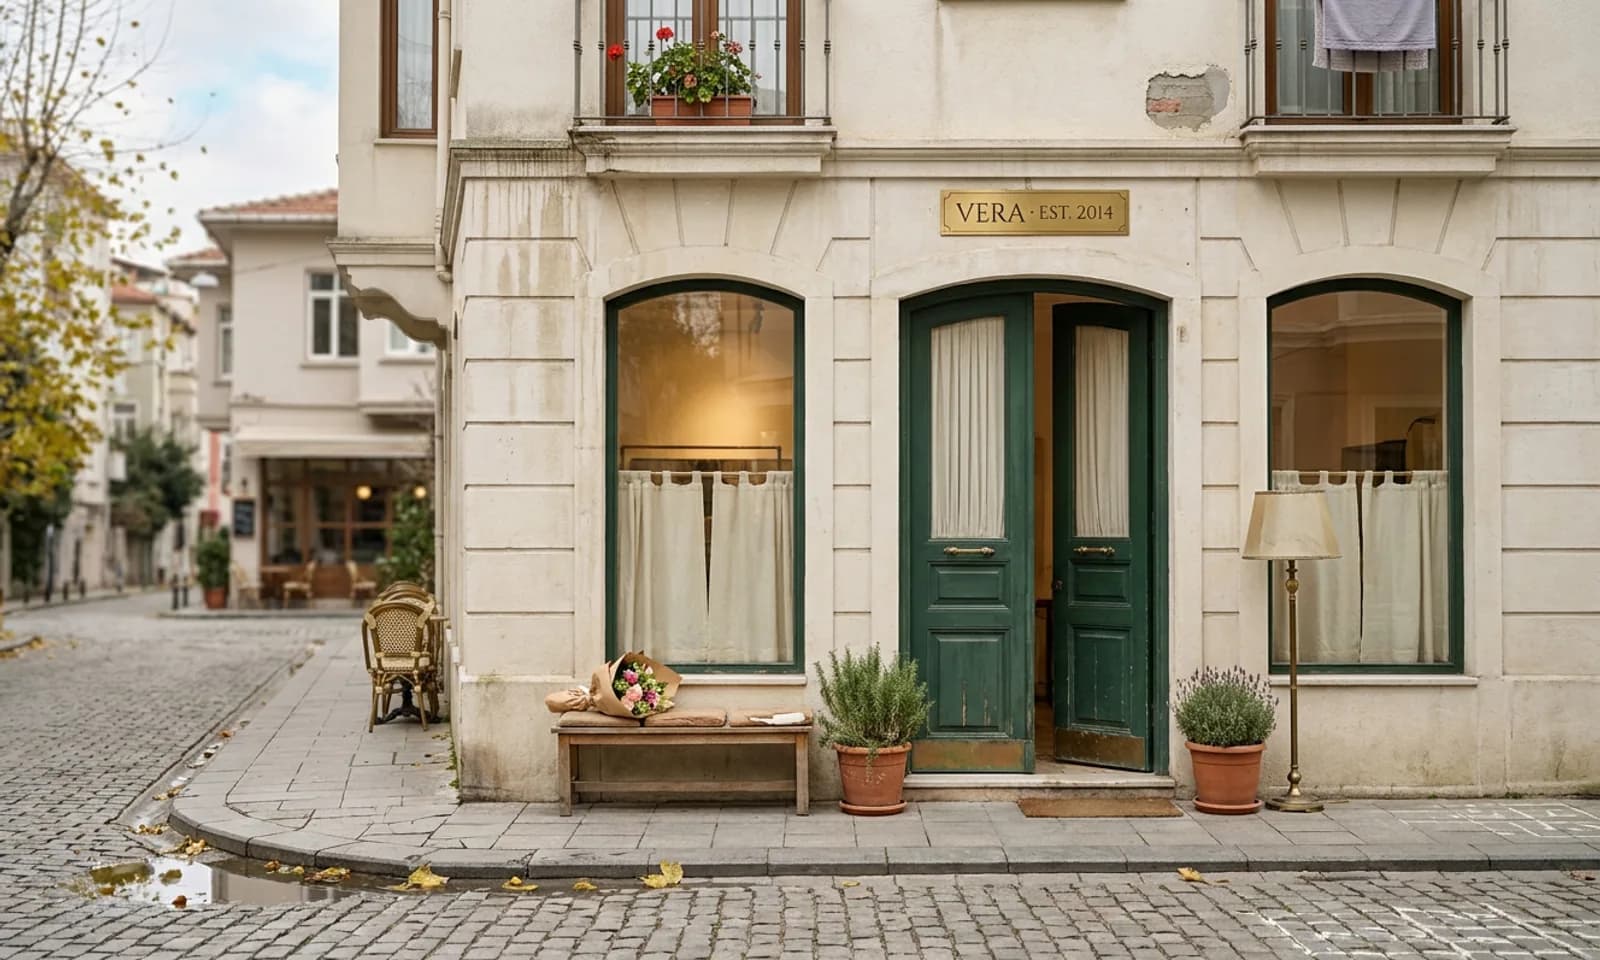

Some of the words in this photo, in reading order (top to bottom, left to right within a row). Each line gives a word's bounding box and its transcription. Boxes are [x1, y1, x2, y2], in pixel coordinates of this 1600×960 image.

[956, 202, 1025, 223] VERA
[1039, 204, 1072, 220] EST.
[1076, 204, 1113, 220] 2014
